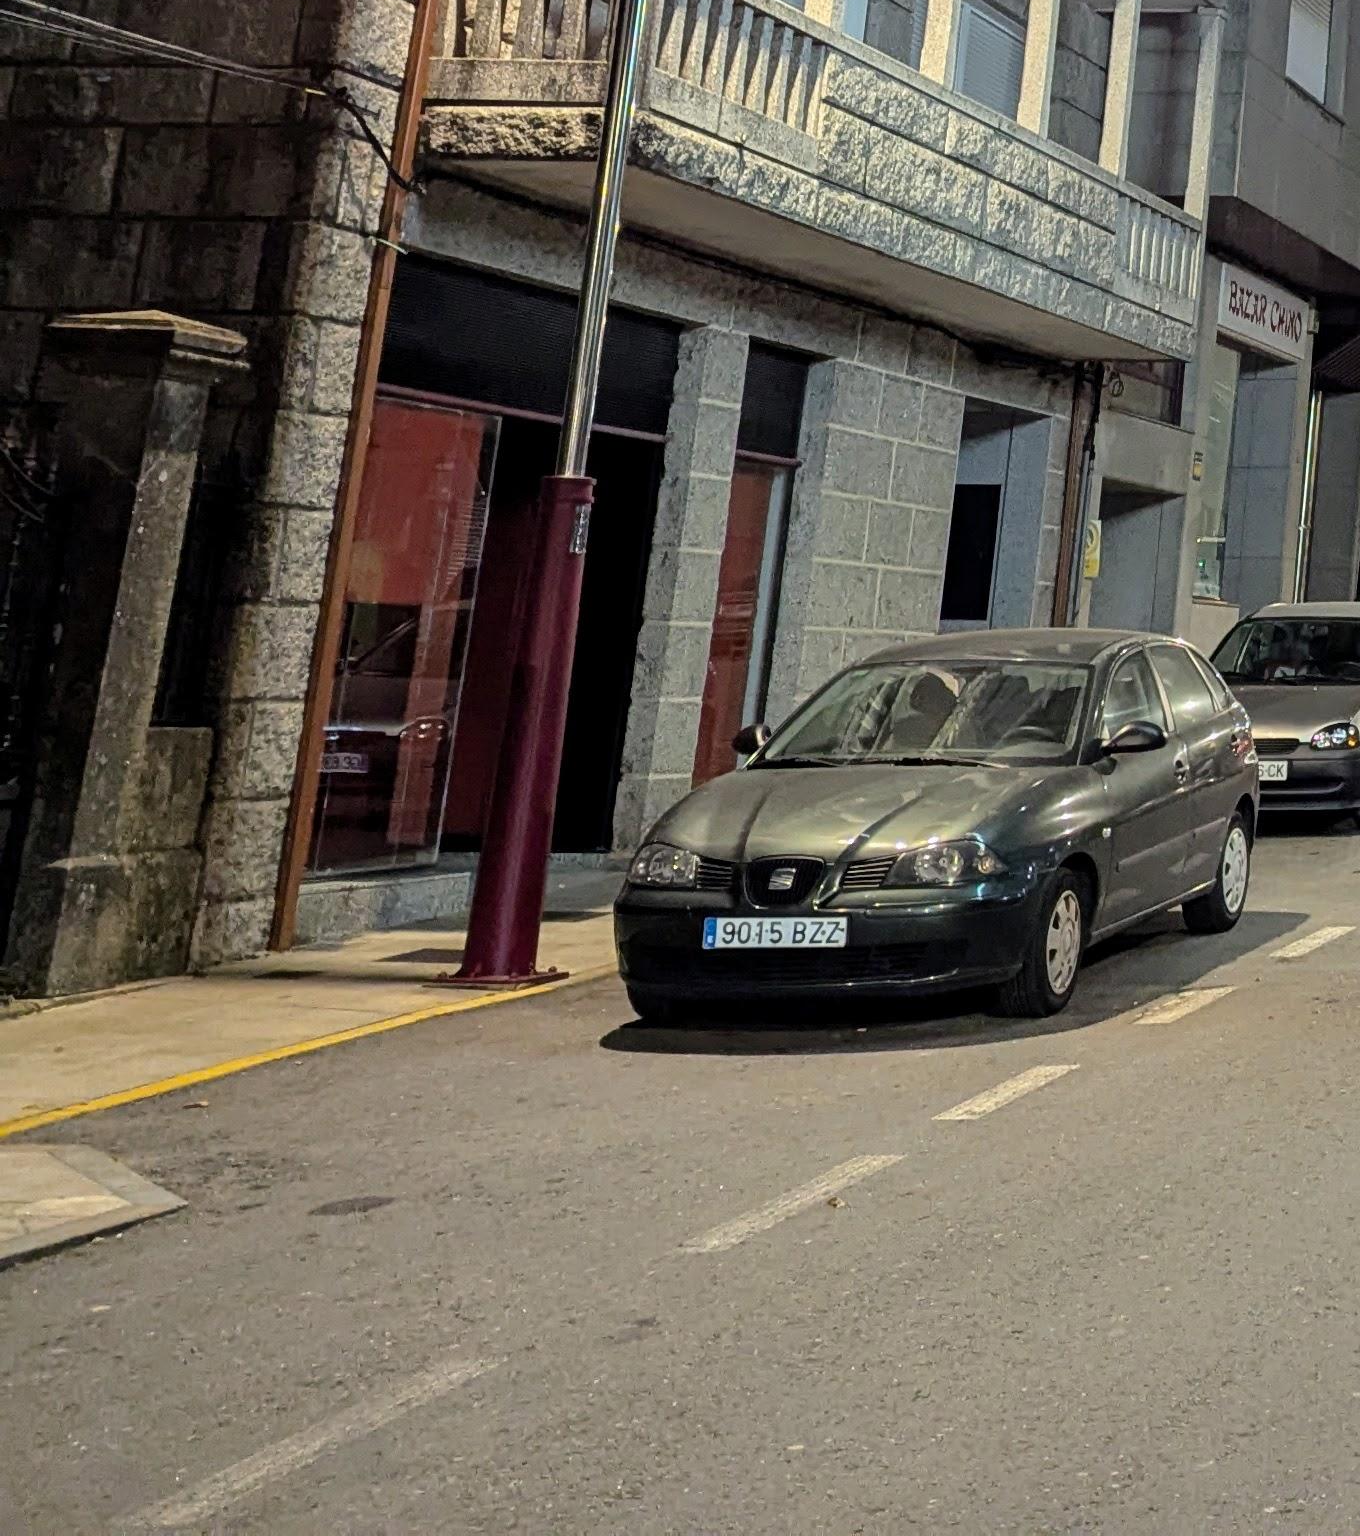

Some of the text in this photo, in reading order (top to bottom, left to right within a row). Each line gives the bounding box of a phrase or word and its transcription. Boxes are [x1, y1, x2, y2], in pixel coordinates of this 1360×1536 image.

[1229, 281, 1302, 343] BAZAR CHINO
[722, 921, 841, 945] 9015 BZZ
